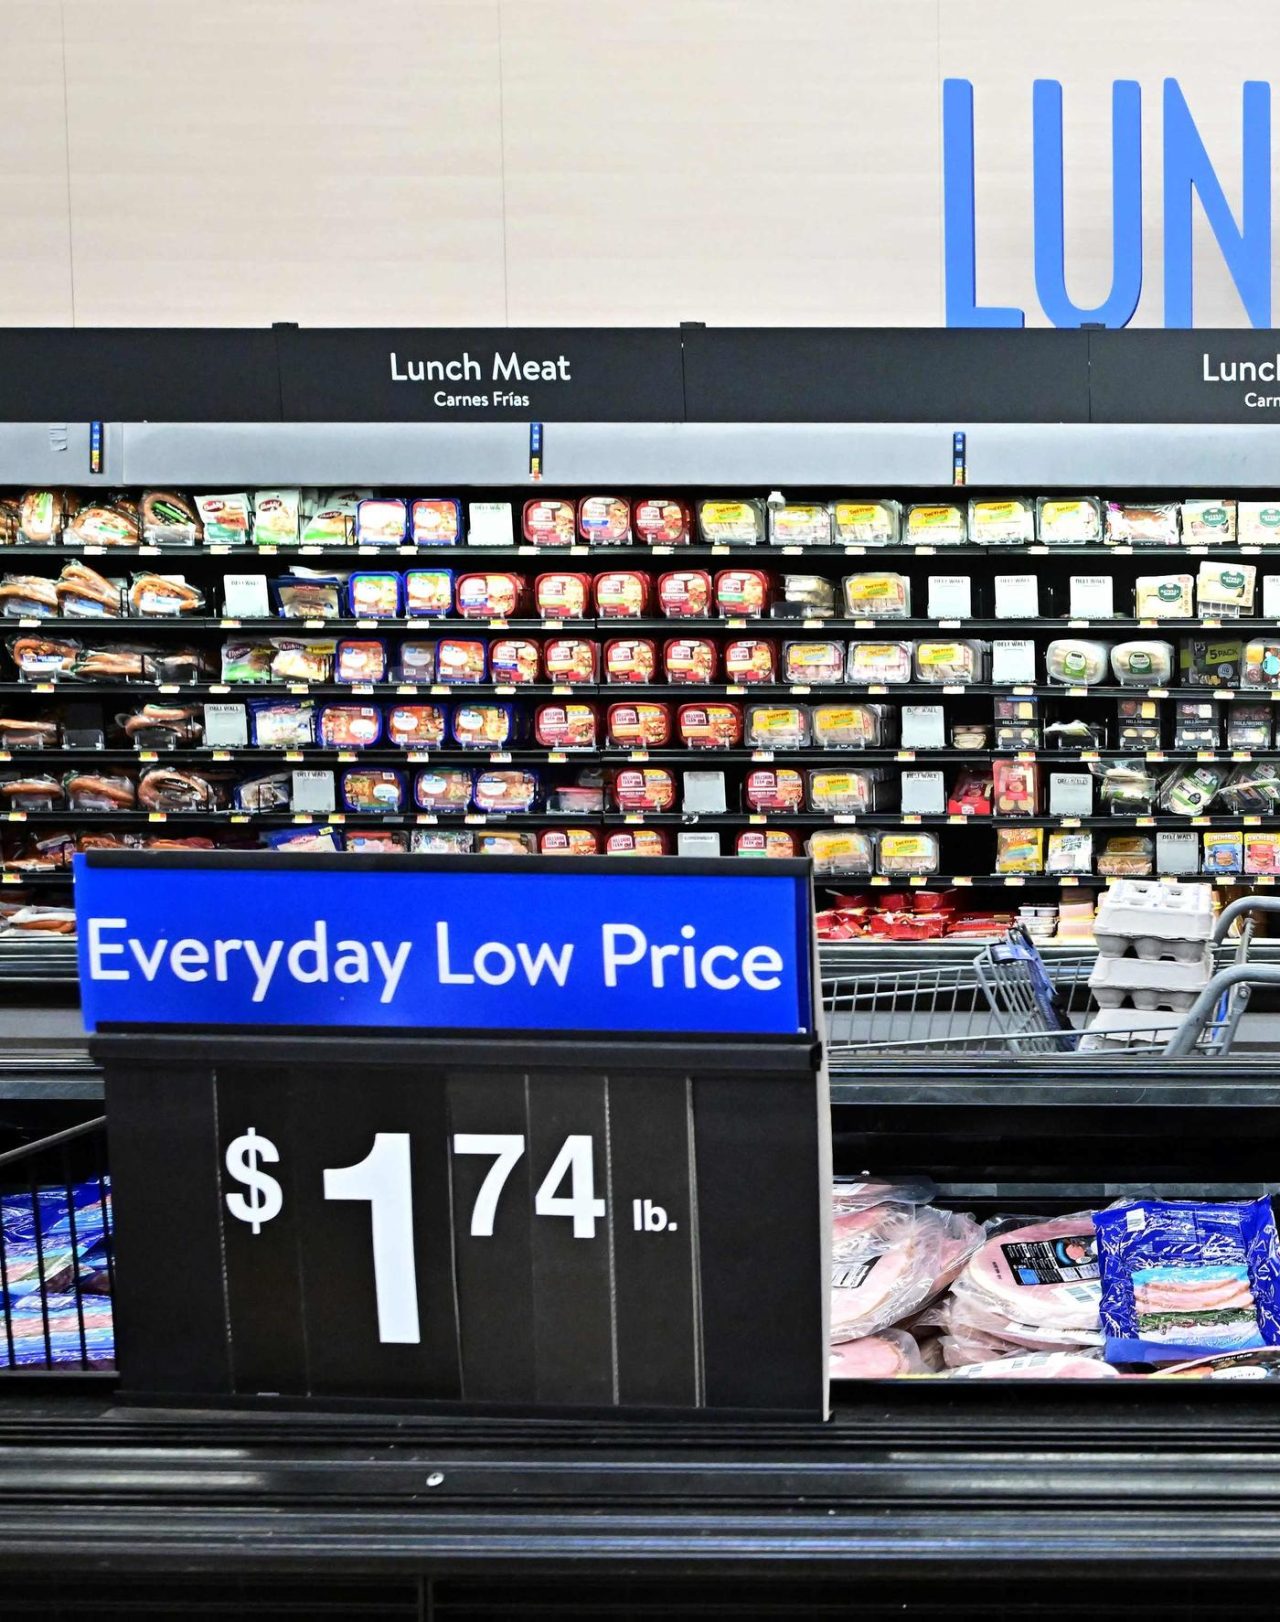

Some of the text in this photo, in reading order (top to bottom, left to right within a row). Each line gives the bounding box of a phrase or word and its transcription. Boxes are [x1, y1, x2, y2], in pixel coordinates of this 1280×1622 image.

[390, 352, 572, 381] Lunch Meat
[433, 391, 530, 407] Carnes Frías
[1217, 645, 1240, 657] PACK
[86, 917, 784, 1004] Everyday Low Price
[225, 1127, 678, 1344] $ 1 74 lb.
